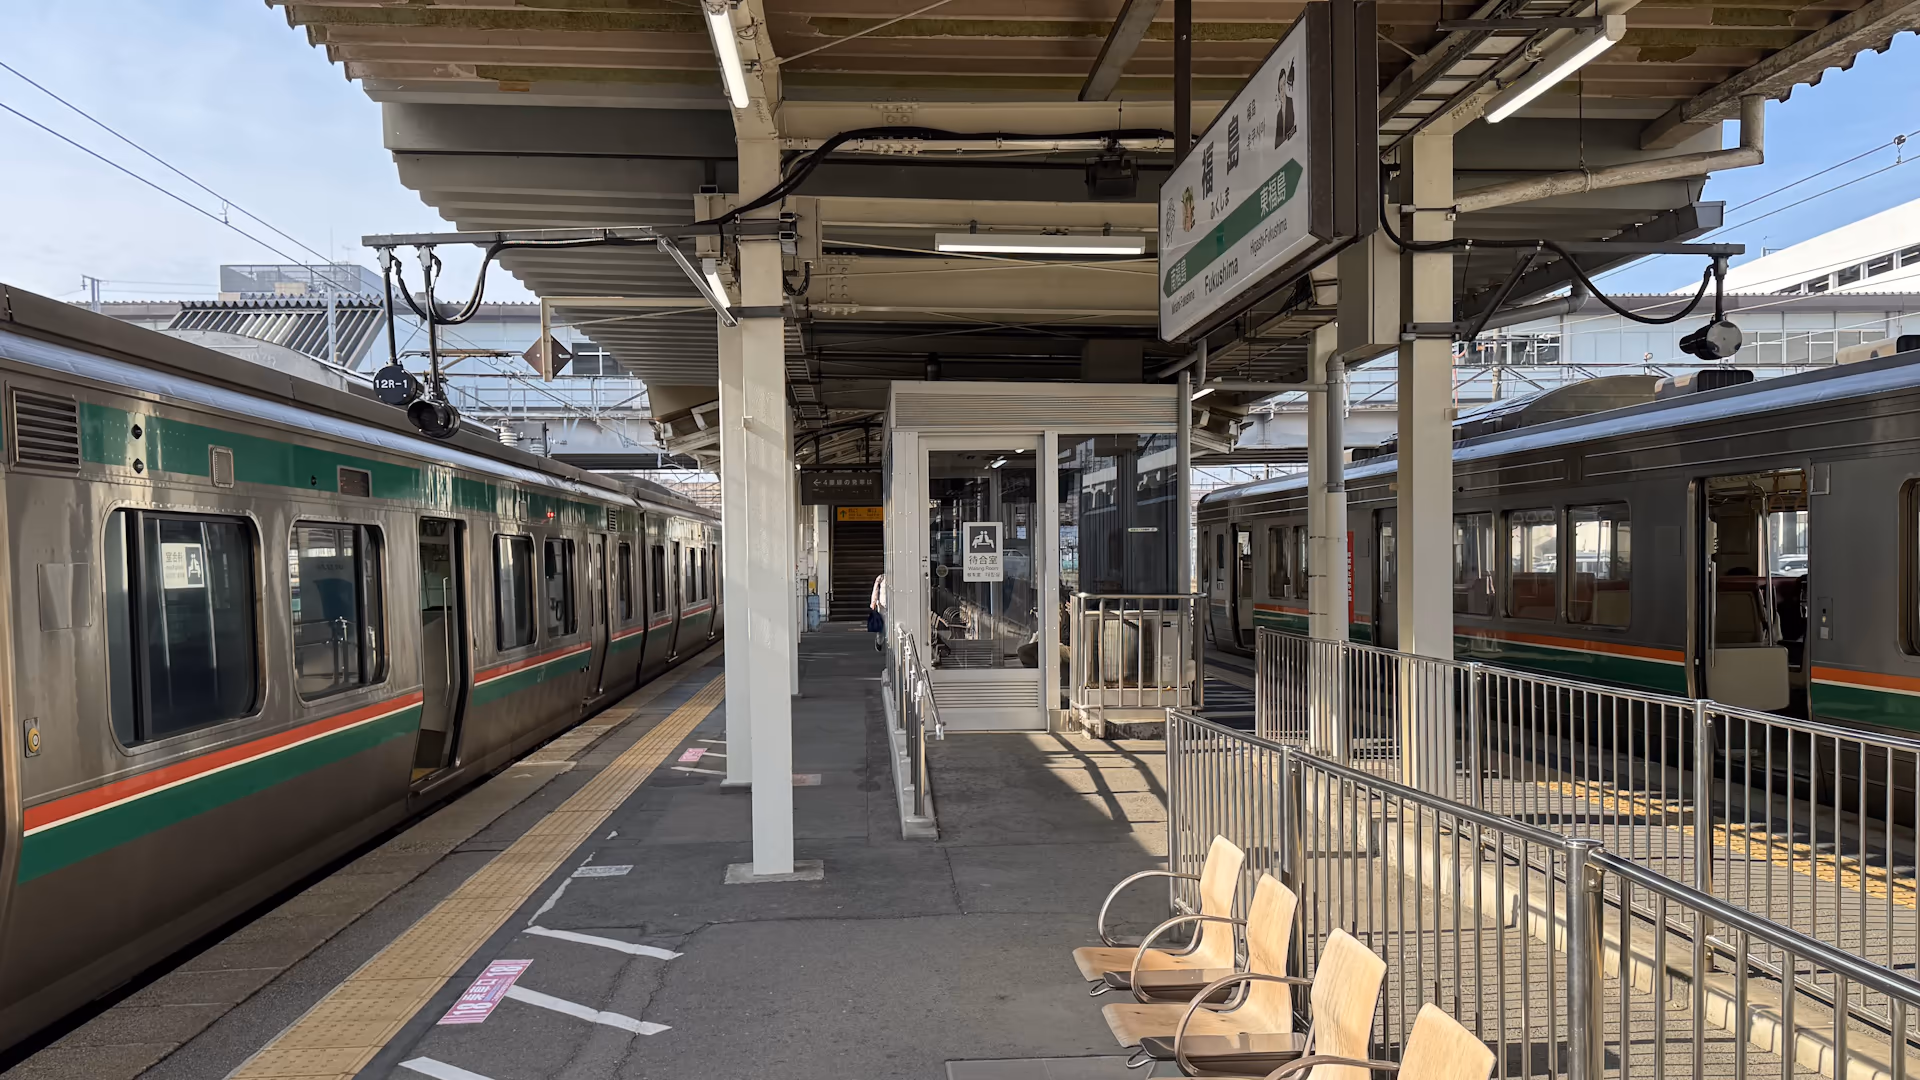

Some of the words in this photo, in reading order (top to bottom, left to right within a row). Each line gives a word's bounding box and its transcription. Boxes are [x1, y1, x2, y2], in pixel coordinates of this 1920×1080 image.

[1201, 113, 1240, 200] 福島
[1210, 187, 1230, 220] ふくしま
[1260, 171, 1287, 217] 東福島
[1250, 218, 1288, 256] Higashi-Fukushima
[1204, 258, 1239, 296] Fukushima
[375, 379, 408, 389] 12R-1
[968, 555, 998, 565] 待合室
[485, 965, 523, 977] 18
[461, 978, 499, 1001] 乗車口
[452, 1002, 493, 1015] 18
